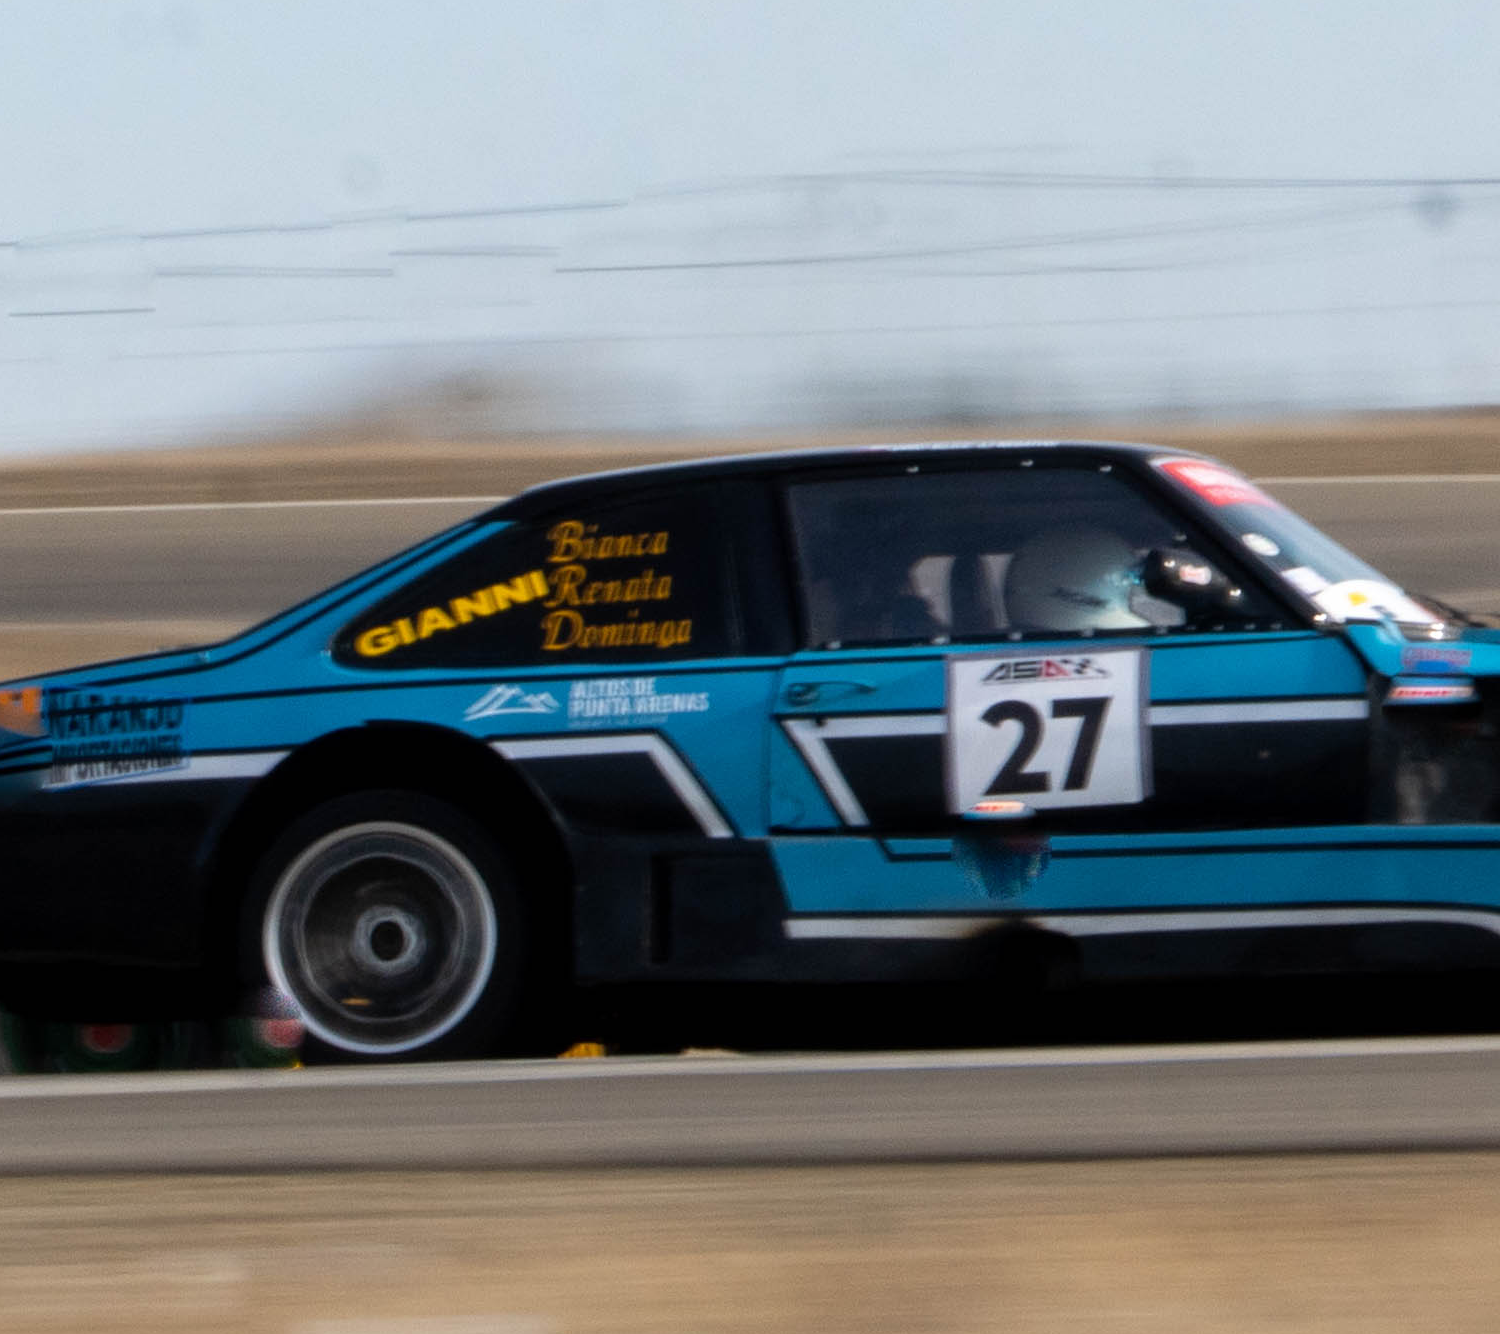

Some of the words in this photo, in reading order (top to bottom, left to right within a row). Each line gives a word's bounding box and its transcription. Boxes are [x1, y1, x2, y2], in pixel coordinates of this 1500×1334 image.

[547, 520, 670, 562] Bianca
[543, 565, 674, 608] Renata
[354, 570, 550, 657] GIANNI
[541, 609, 693, 651] Dominga
[980, 695, 1114, 797] 27
